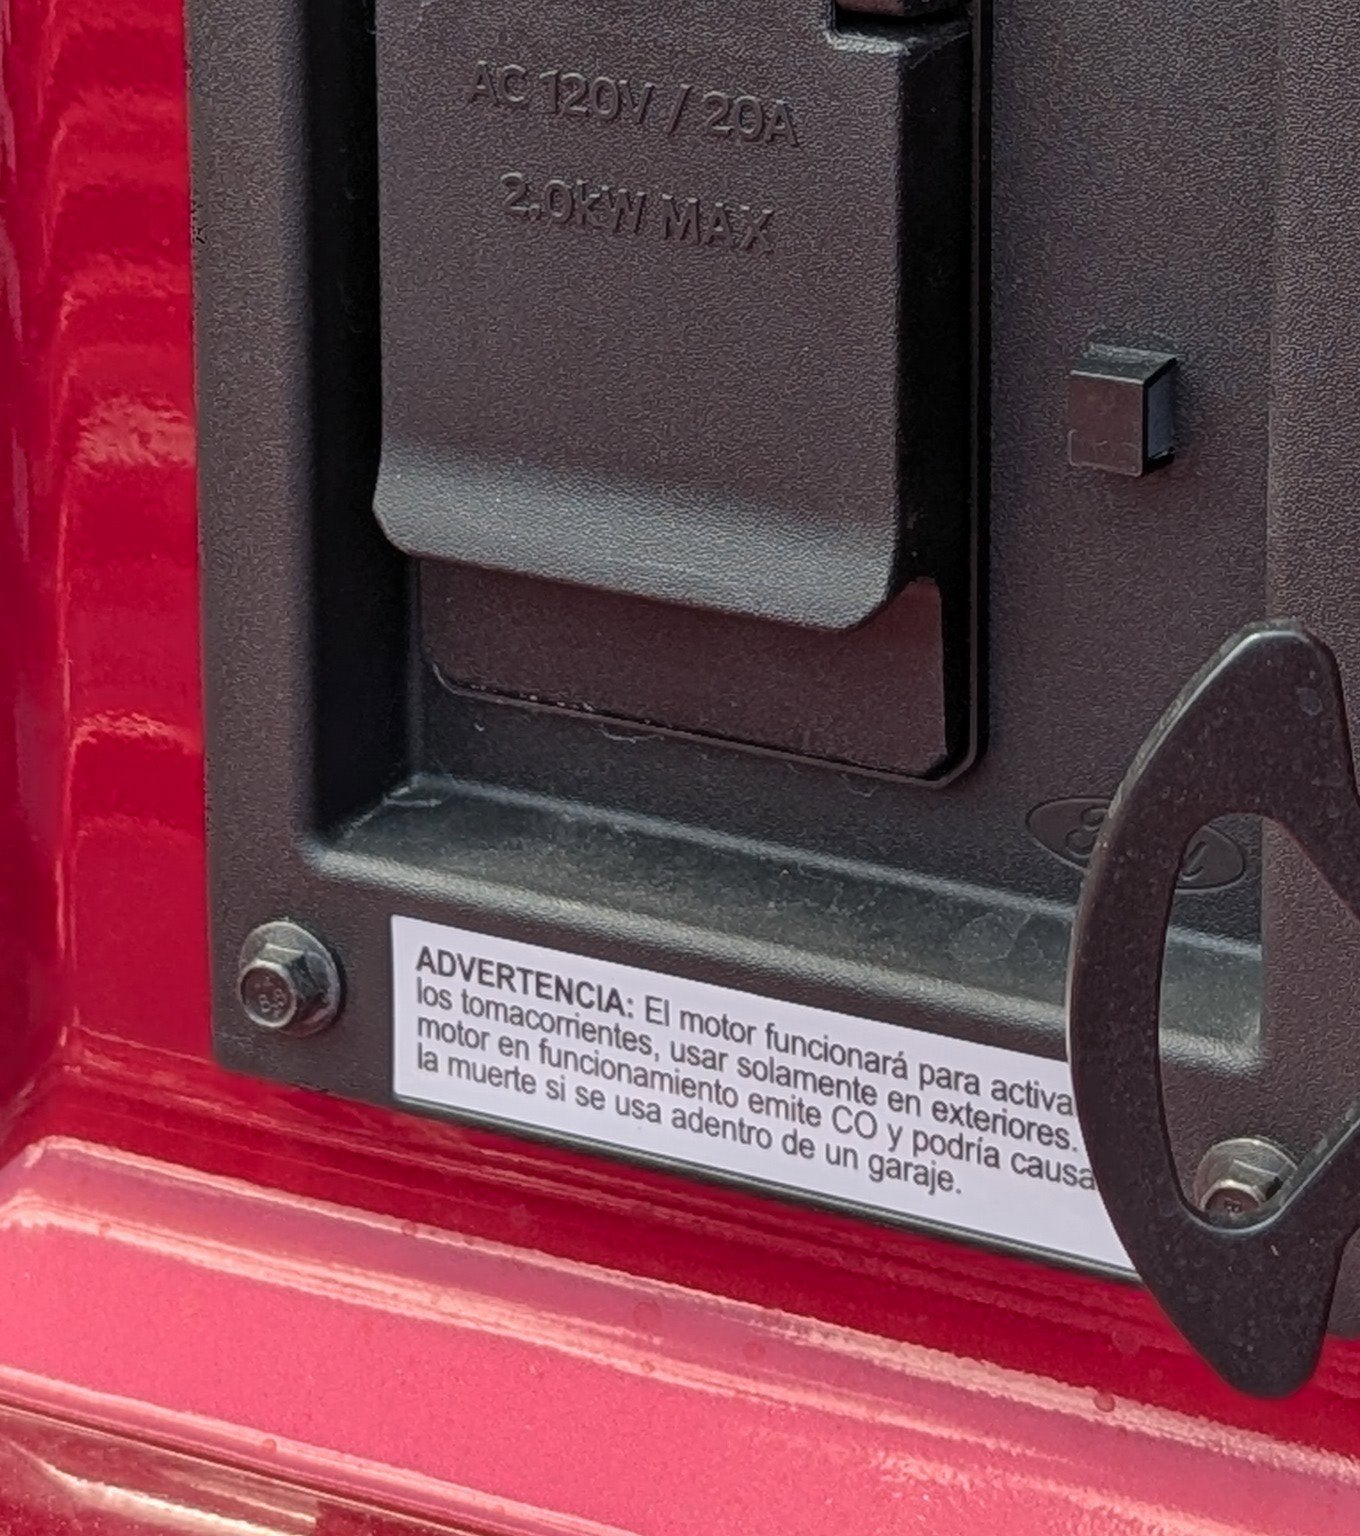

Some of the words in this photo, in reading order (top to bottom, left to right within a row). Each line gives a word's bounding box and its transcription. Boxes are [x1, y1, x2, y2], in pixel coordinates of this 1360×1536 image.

[468, 61, 529, 107] AC
[539, 69, 655, 125] 120V
[666, 83, 692, 137] /
[702, 90, 801, 148] 20A
[660, 193, 774, 253] MAX
[415, 945, 634, 1019] ADVERTENCIA:
[644, 994, 670, 1027] El
[679, 1009, 758, 1046] motor
[764, 1022, 909, 1081] funcionará
[918, 1062, 981, 1097] para
[990, 1078, 1074, 1117] activa
[416, 976, 453, 1011] los
[460, 988, 660, 1062] tomacorrientes,
[670, 1040, 729, 1072] usar
[737, 1056, 878, 1107] solamente
[887, 1090, 922, 1118] en
[931, 1100, 1078, 1153] exteriores.
[417, 1016, 491, 1051] motor
[497, 1035, 530, 1061] en
[538, 1037, 739, 1109] funcionamiento
[747, 1092, 822, 1128] emite
[831, 1104, 878, 1140] CO
[887, 1123, 904, 1153] y
[912, 1129, 1001, 1170] podría
[1010, 1149, 1097, 1192] causa
[417, 1042, 439, 1073] la
[448, 1056, 537, 1095] muerte
[545, 1074, 566, 1102] si
[575, 1085, 606, 1111] se
[615, 1094, 662, 1124] usa
[671, 1106, 773, 1150] adentro
[781, 1128, 816, 1160] de
[825, 1143, 859, 1170] un
[868, 1153, 962, 1196] garaje.
